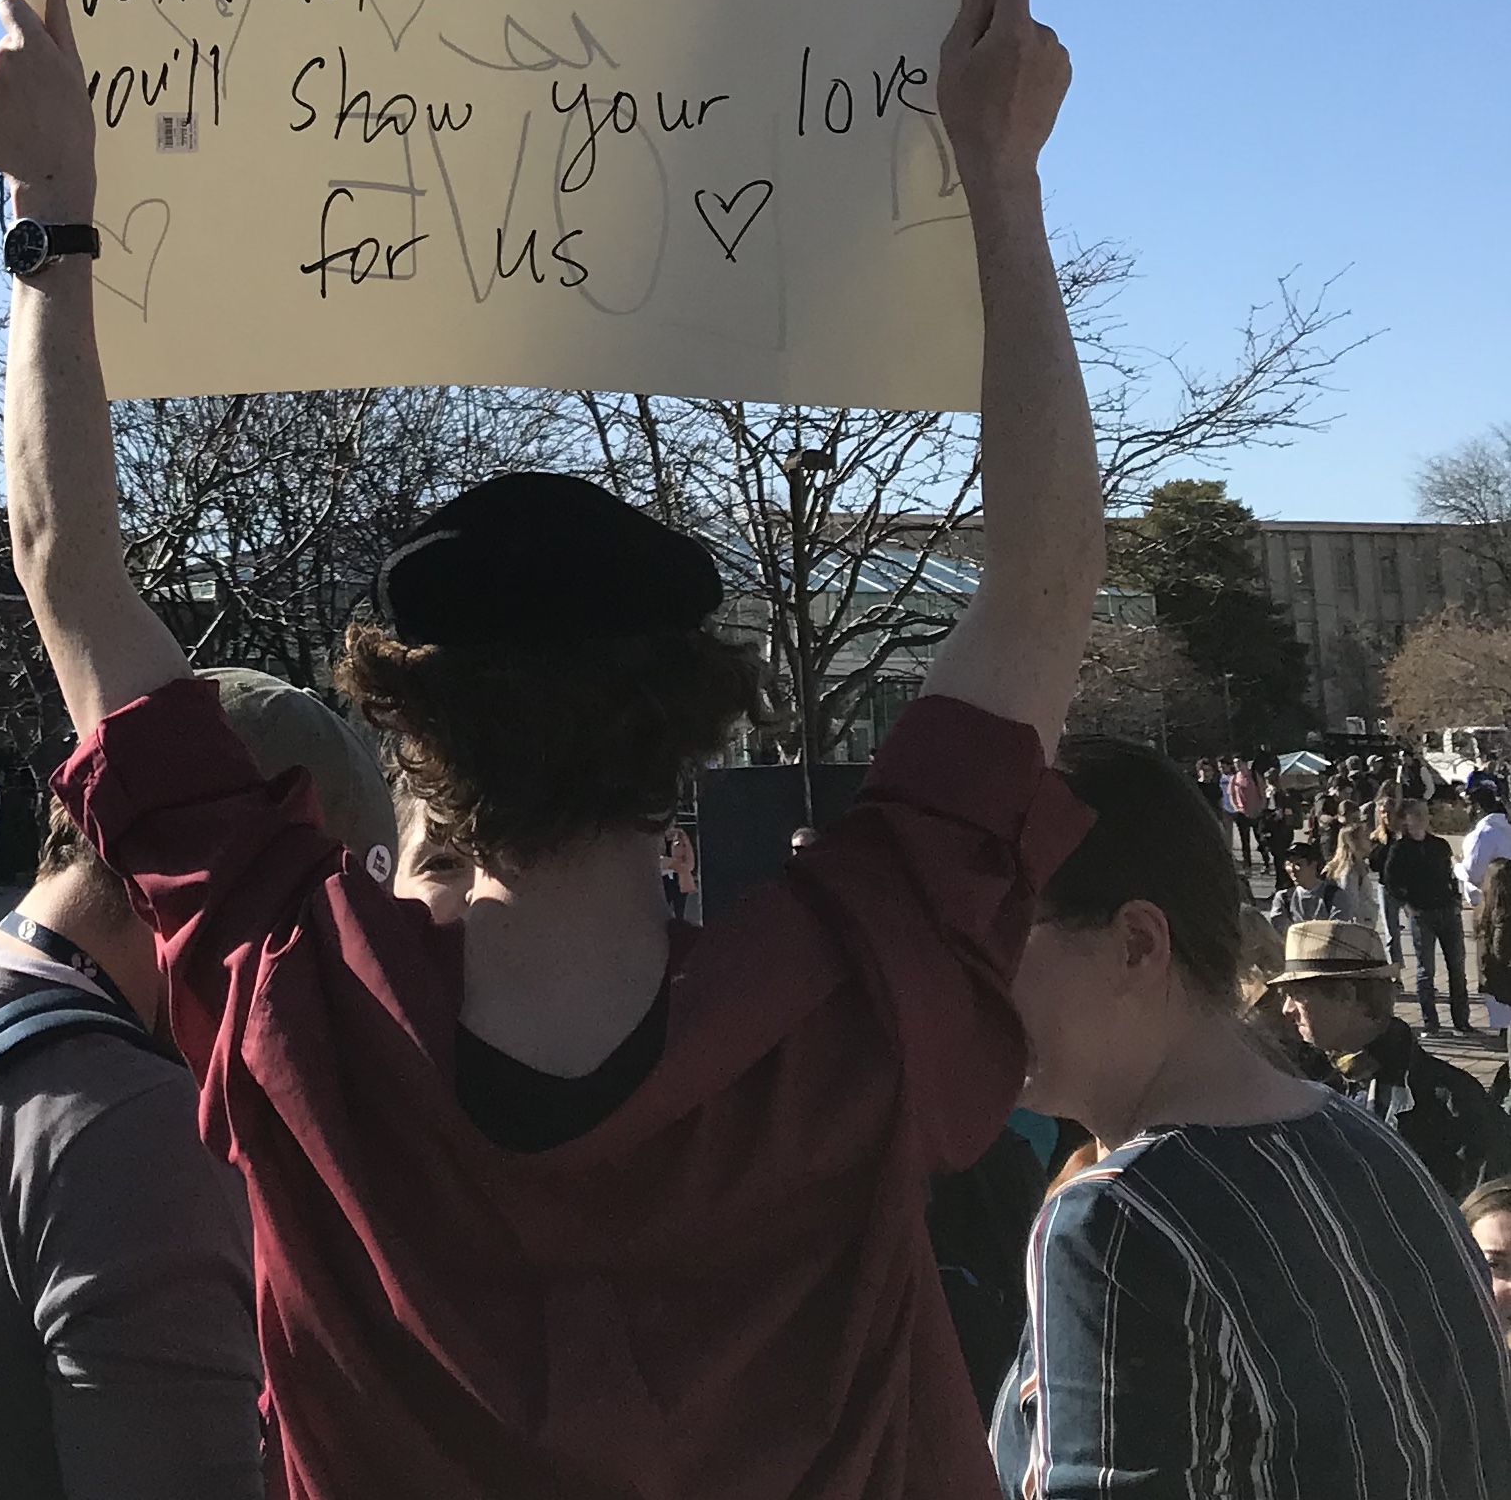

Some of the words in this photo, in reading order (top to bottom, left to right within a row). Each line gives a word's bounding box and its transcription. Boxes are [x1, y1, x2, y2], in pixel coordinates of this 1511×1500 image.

[86, 37, 221, 130] ou'll
[550, 79, 731, 194] your
[797, 45, 938, 138] love
[299, 186, 430, 300] for
[495, 226, 590, 289] us
